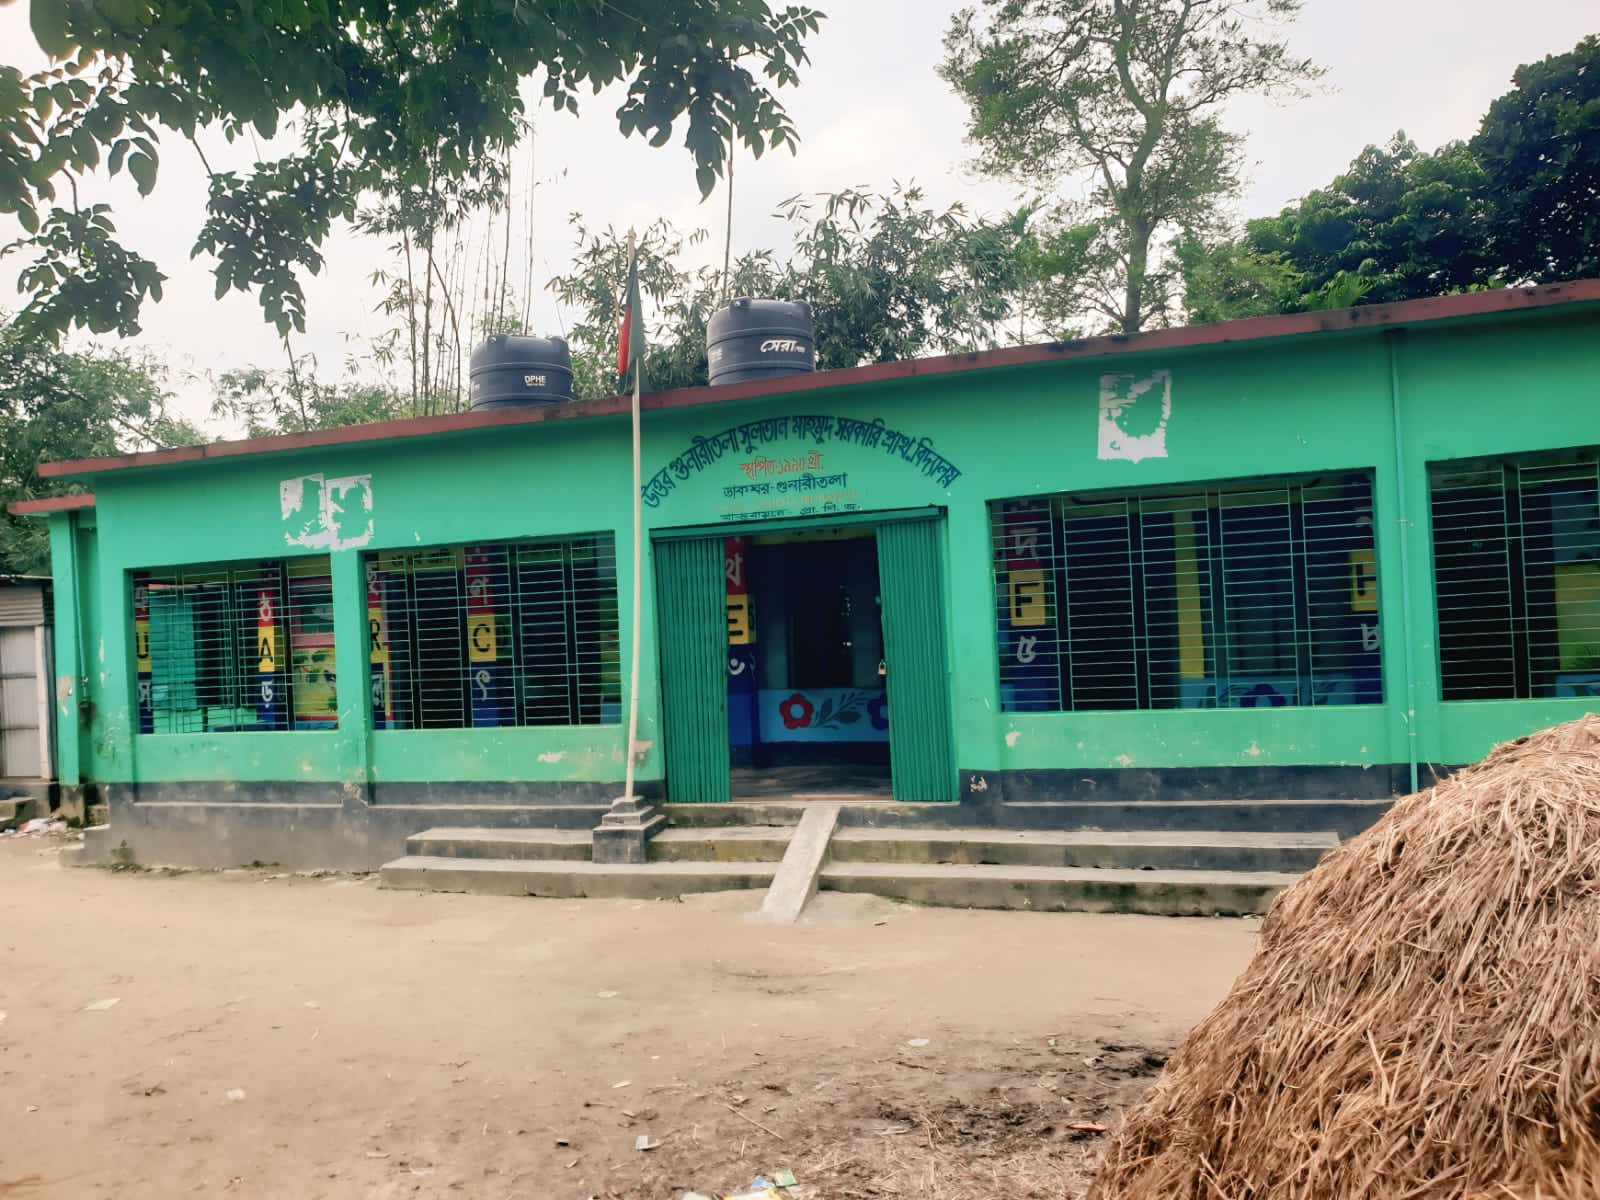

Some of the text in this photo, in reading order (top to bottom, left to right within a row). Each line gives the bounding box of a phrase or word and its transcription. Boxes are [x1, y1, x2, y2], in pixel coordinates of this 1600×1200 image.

[760, 339, 797, 353] সেরা
[524, 374, 547, 384] DPHE
[641, 466, 677, 508] উত্তর
[738, 416, 791, 455] সুলতান
[834, 416, 887, 449] সরকারি
[1015, 582, 1041, 618] F
[136, 631, 149, 659] U
[370, 619, 381, 651] R
[473, 623, 491, 652] C
[258, 637, 275, 663] A
